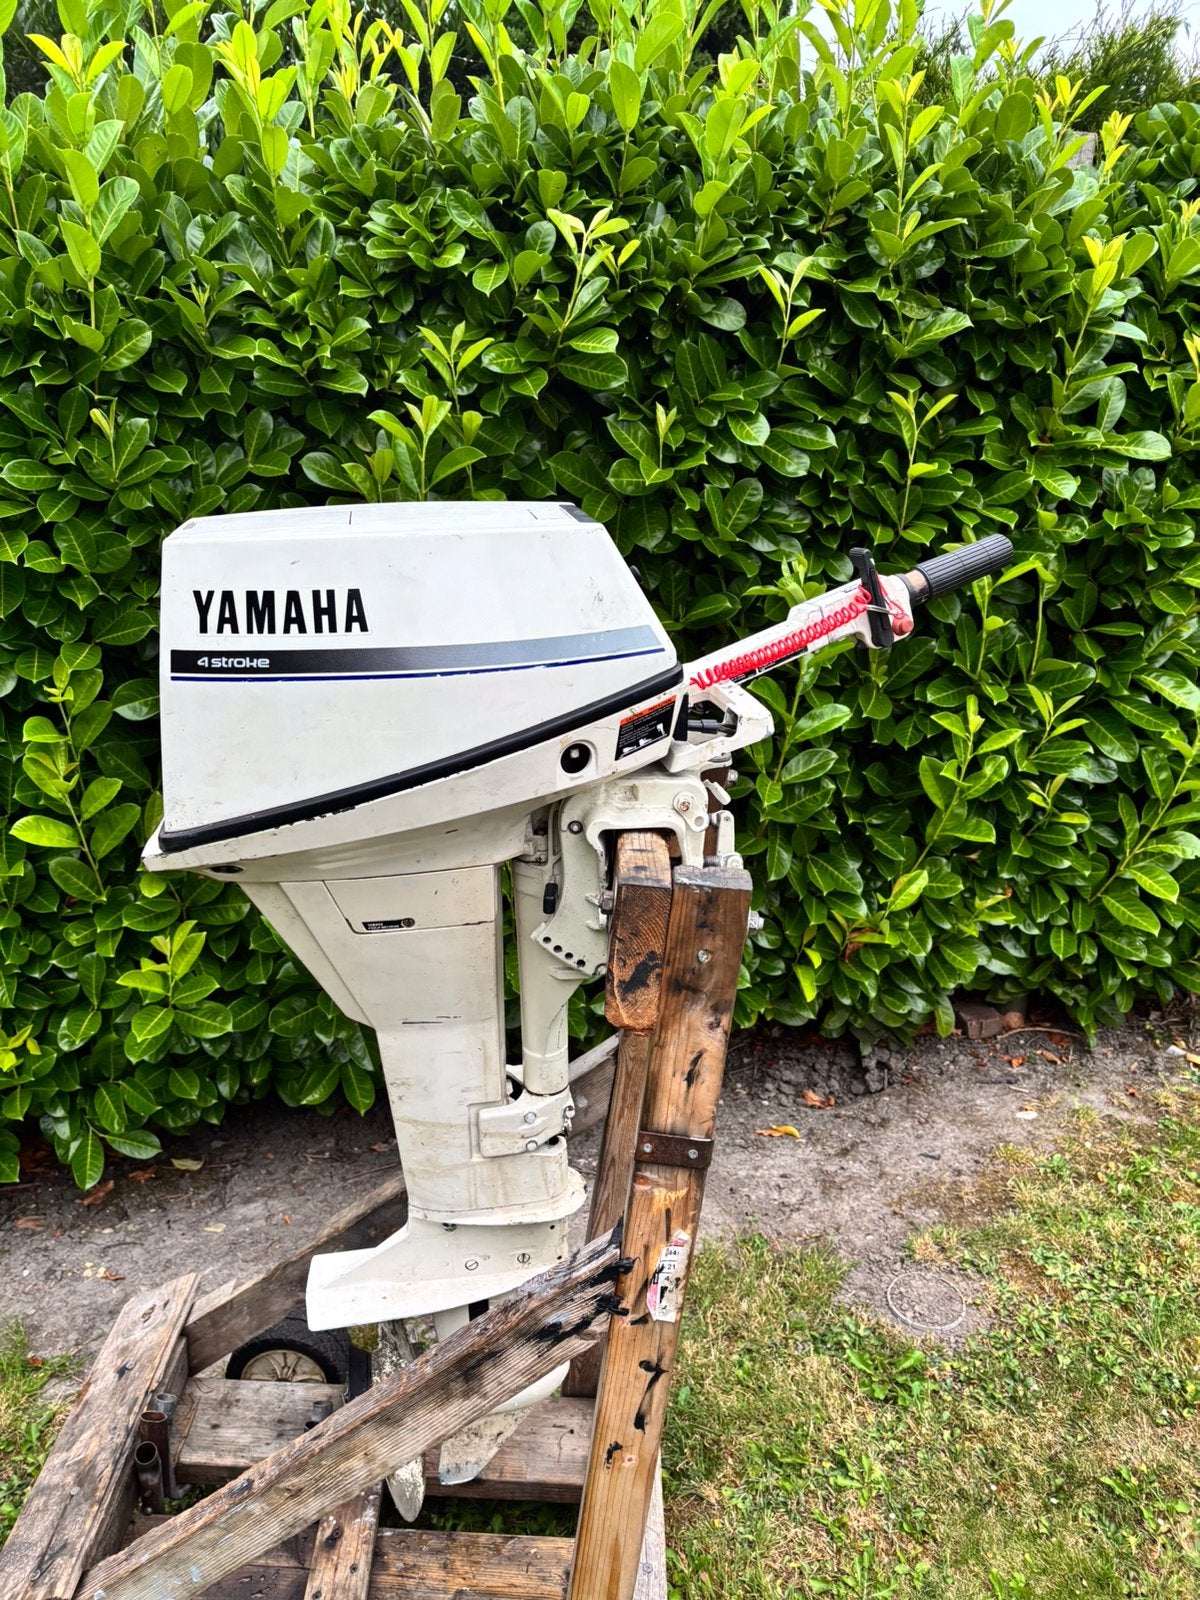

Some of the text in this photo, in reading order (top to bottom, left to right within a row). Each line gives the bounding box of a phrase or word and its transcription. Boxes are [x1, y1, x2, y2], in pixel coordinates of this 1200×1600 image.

[193, 588, 369, 634] YAMAHA
[197, 656, 270, 668] 4 stroke
